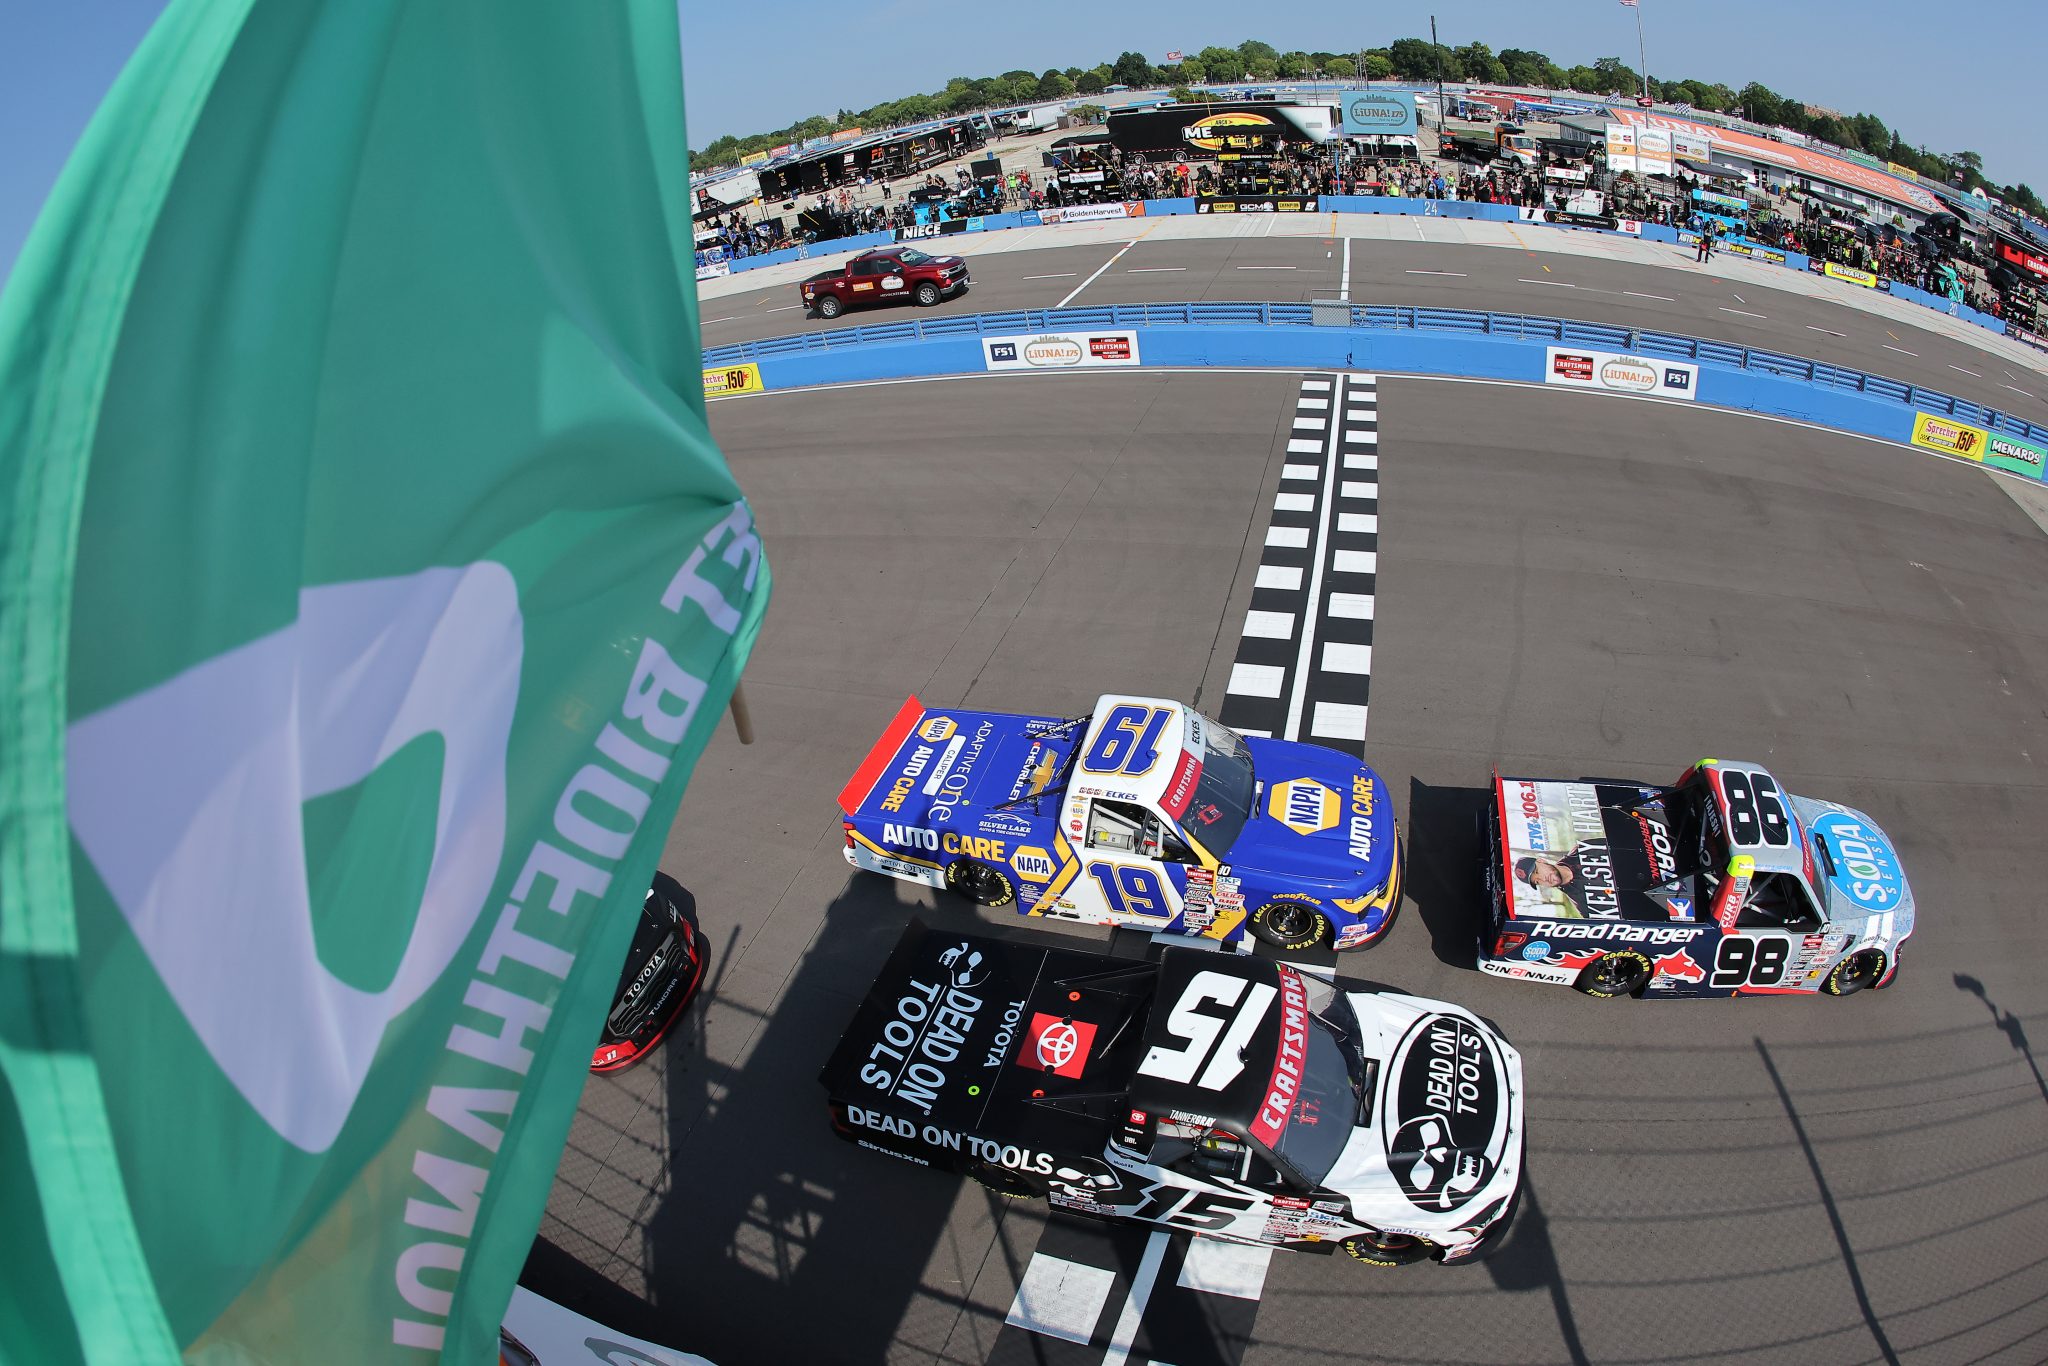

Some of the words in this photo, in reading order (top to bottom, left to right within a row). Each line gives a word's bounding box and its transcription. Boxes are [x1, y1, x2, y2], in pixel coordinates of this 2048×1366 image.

[1354, 107, 1390, 117] LiUNA!
[1391, 110, 1404, 118] 175
[1128, 203, 1138, 214] 7
[1424, 200, 1438, 216] 24
[902, 223, 941, 240] NIECE
[1832, 265, 1870, 282] MENARDS
[994, 347, 1013, 356] FS1
[1028, 348, 1064, 359] LiUNA!
[1092, 342, 1128, 350] CRAFTSMAN
[726, 370, 744, 389] 150
[1556, 360, 1591, 370] CRAFTSMAN
[1604, 369, 1640, 382] LiUNA!
[1641, 375, 1654, 384] 175
[1667, 372, 1687, 385] FS1
[1926, 420, 1958, 440] Sprecher
[1955, 430, 1975, 452] 150
[1991, 439, 2041, 465] MENARDS
[925, 719, 950, 738] NAPA
[1191, 720, 1200, 745] ECKES
[903, 745, 934, 777] AUTO
[956, 720, 994, 774] ADAPTIVE
[934, 749, 956, 780] CALIPER
[880, 777, 915, 813] CARE
[1106, 790, 1138, 800] ECKES
[1169, 757, 1197, 808] CRAFTSMAN
[1351, 775, 1373, 816] CARE
[928, 774, 969, 822] One
[1288, 786, 1321, 825] NAPA
[1519, 780, 1539, 820] 106.1
[1565, 785, 1604, 833] HART
[979, 820, 1007, 830] SILVER
[1008, 825, 1031, 833] LAKE
[1348, 816, 1373, 862] AUTO
[883, 823, 938, 851] AUTO
[943, 833, 1005, 863] CARE
[1638, 815, 1660, 880] PERFORMANC
[870, 856, 902, 867] ADAPTIVE
[948, 862, 957, 883] EAGLE
[1017, 855, 1049, 874] NAPA
[1218, 865, 1231, 876] 10
[1830, 824, 1887, 903] SODA
[1865, 835, 1897, 895] SENSE
[990, 872, 1013, 907] GOODYEAR
[1087, 861, 1174, 920] 19
[1577, 840, 1620, 920] KELSEY
[1253, 904, 1272, 923] EAGLE
[1272, 893, 1321, 905] GOODYEAR
[1720, 894, 1737, 928] CURB
[1287, 914, 1325, 950] GOODYEAR
[1531, 921, 1606, 940] Road
[1607, 924, 1704, 945] Ranger
[1525, 947, 1548, 956] SODA
[1603, 950, 1650, 972] GOODYEAR
[1708, 935, 1793, 989] 98
[627, 954, 662, 999] TOYOTA
[1484, 963, 1568, 983] CINCINNATI
[649, 978, 677, 1016] TUNDRA
[1587, 988, 1613, 998] EAGLE
[861, 979, 941, 1090] TOOLS
[921, 988, 983, 1062] DEAD
[983, 1000, 1026, 1068] TOYOTA
[1262, 975, 1305, 1130] CRAFTSMAN
[1431, 1026, 1456, 1056] ON
[896, 1063, 946, 1111] ON
[1426, 1057, 1454, 1112] DEAD
[1457, 1033, 1482, 1114] TOOLS
[848, 1104, 917, 1139] DEAD
[922, 1126, 961, 1151] ON
[967, 1136, 1054, 1175] TOOLS
[1150, 1184, 1258, 1234] 15
[1274, 1199, 1308, 1207] CRAFTSMAN
[1309, 1211, 1341, 1220] SKF
[1305, 1218, 1339, 1228] JESEL
[1346, 1241, 1398, 1267] GOODYEAR
